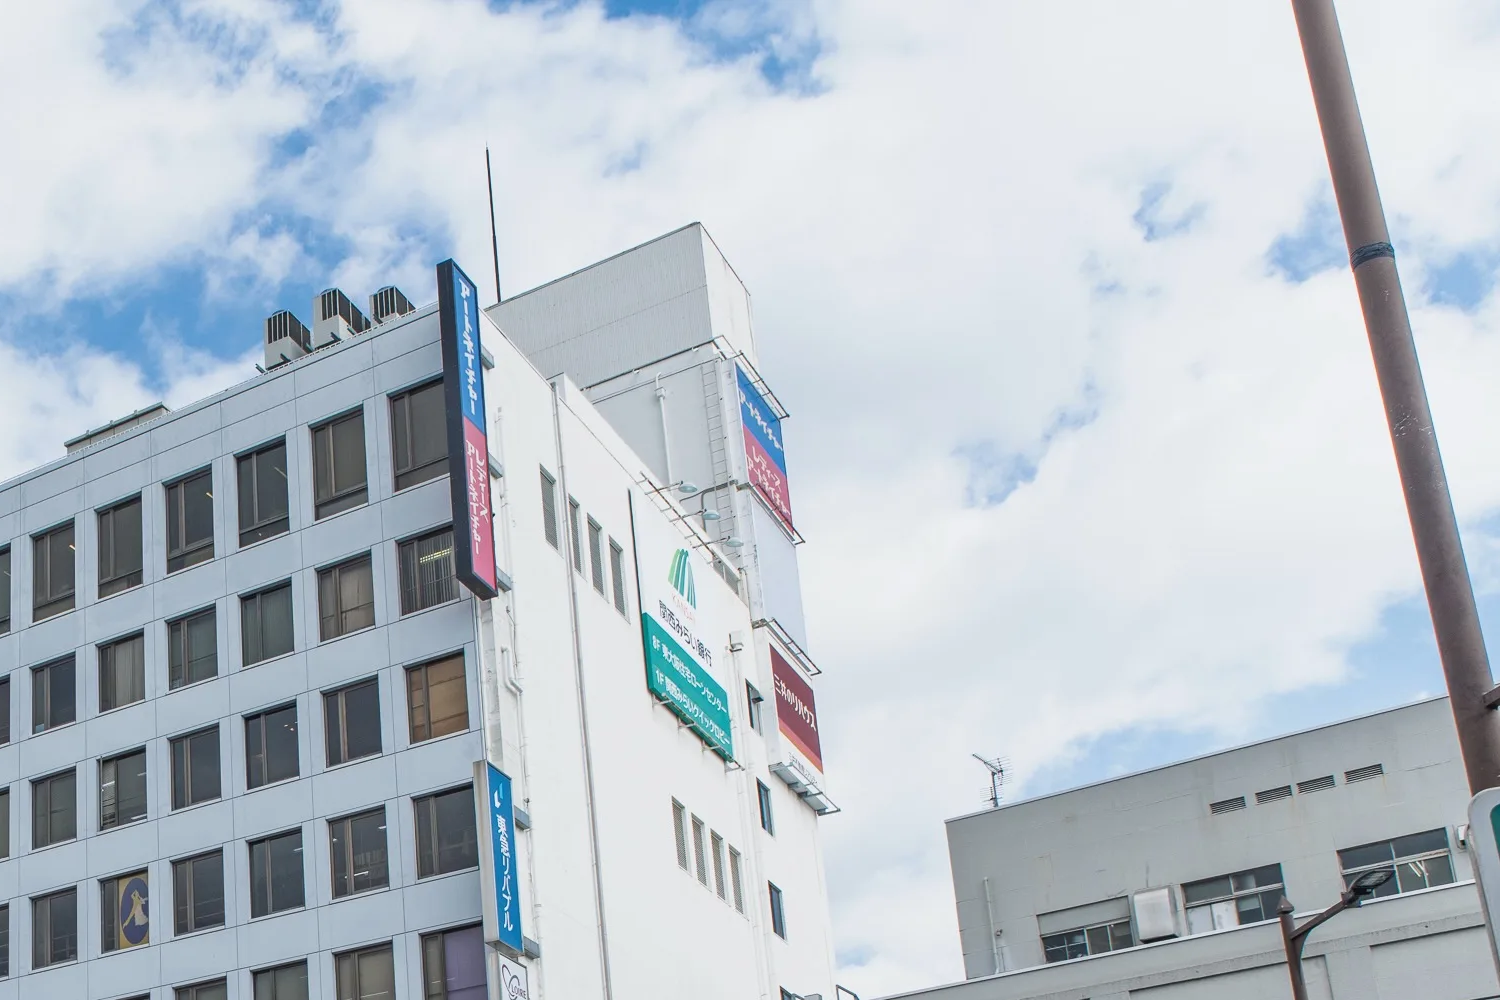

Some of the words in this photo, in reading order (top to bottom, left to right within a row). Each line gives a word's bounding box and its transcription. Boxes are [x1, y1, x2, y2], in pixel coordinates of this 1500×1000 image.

[658, 599, 713, 667] 関西みらい銀行
[651, 635, 661, 653] 8F
[662, 643, 728, 714] 東大阪住宅ローンセンター
[655, 669, 664, 686] 1F
[773, 673, 817, 732] 三井のリハウス
[495, 813, 513, 932] 東急リバブル
